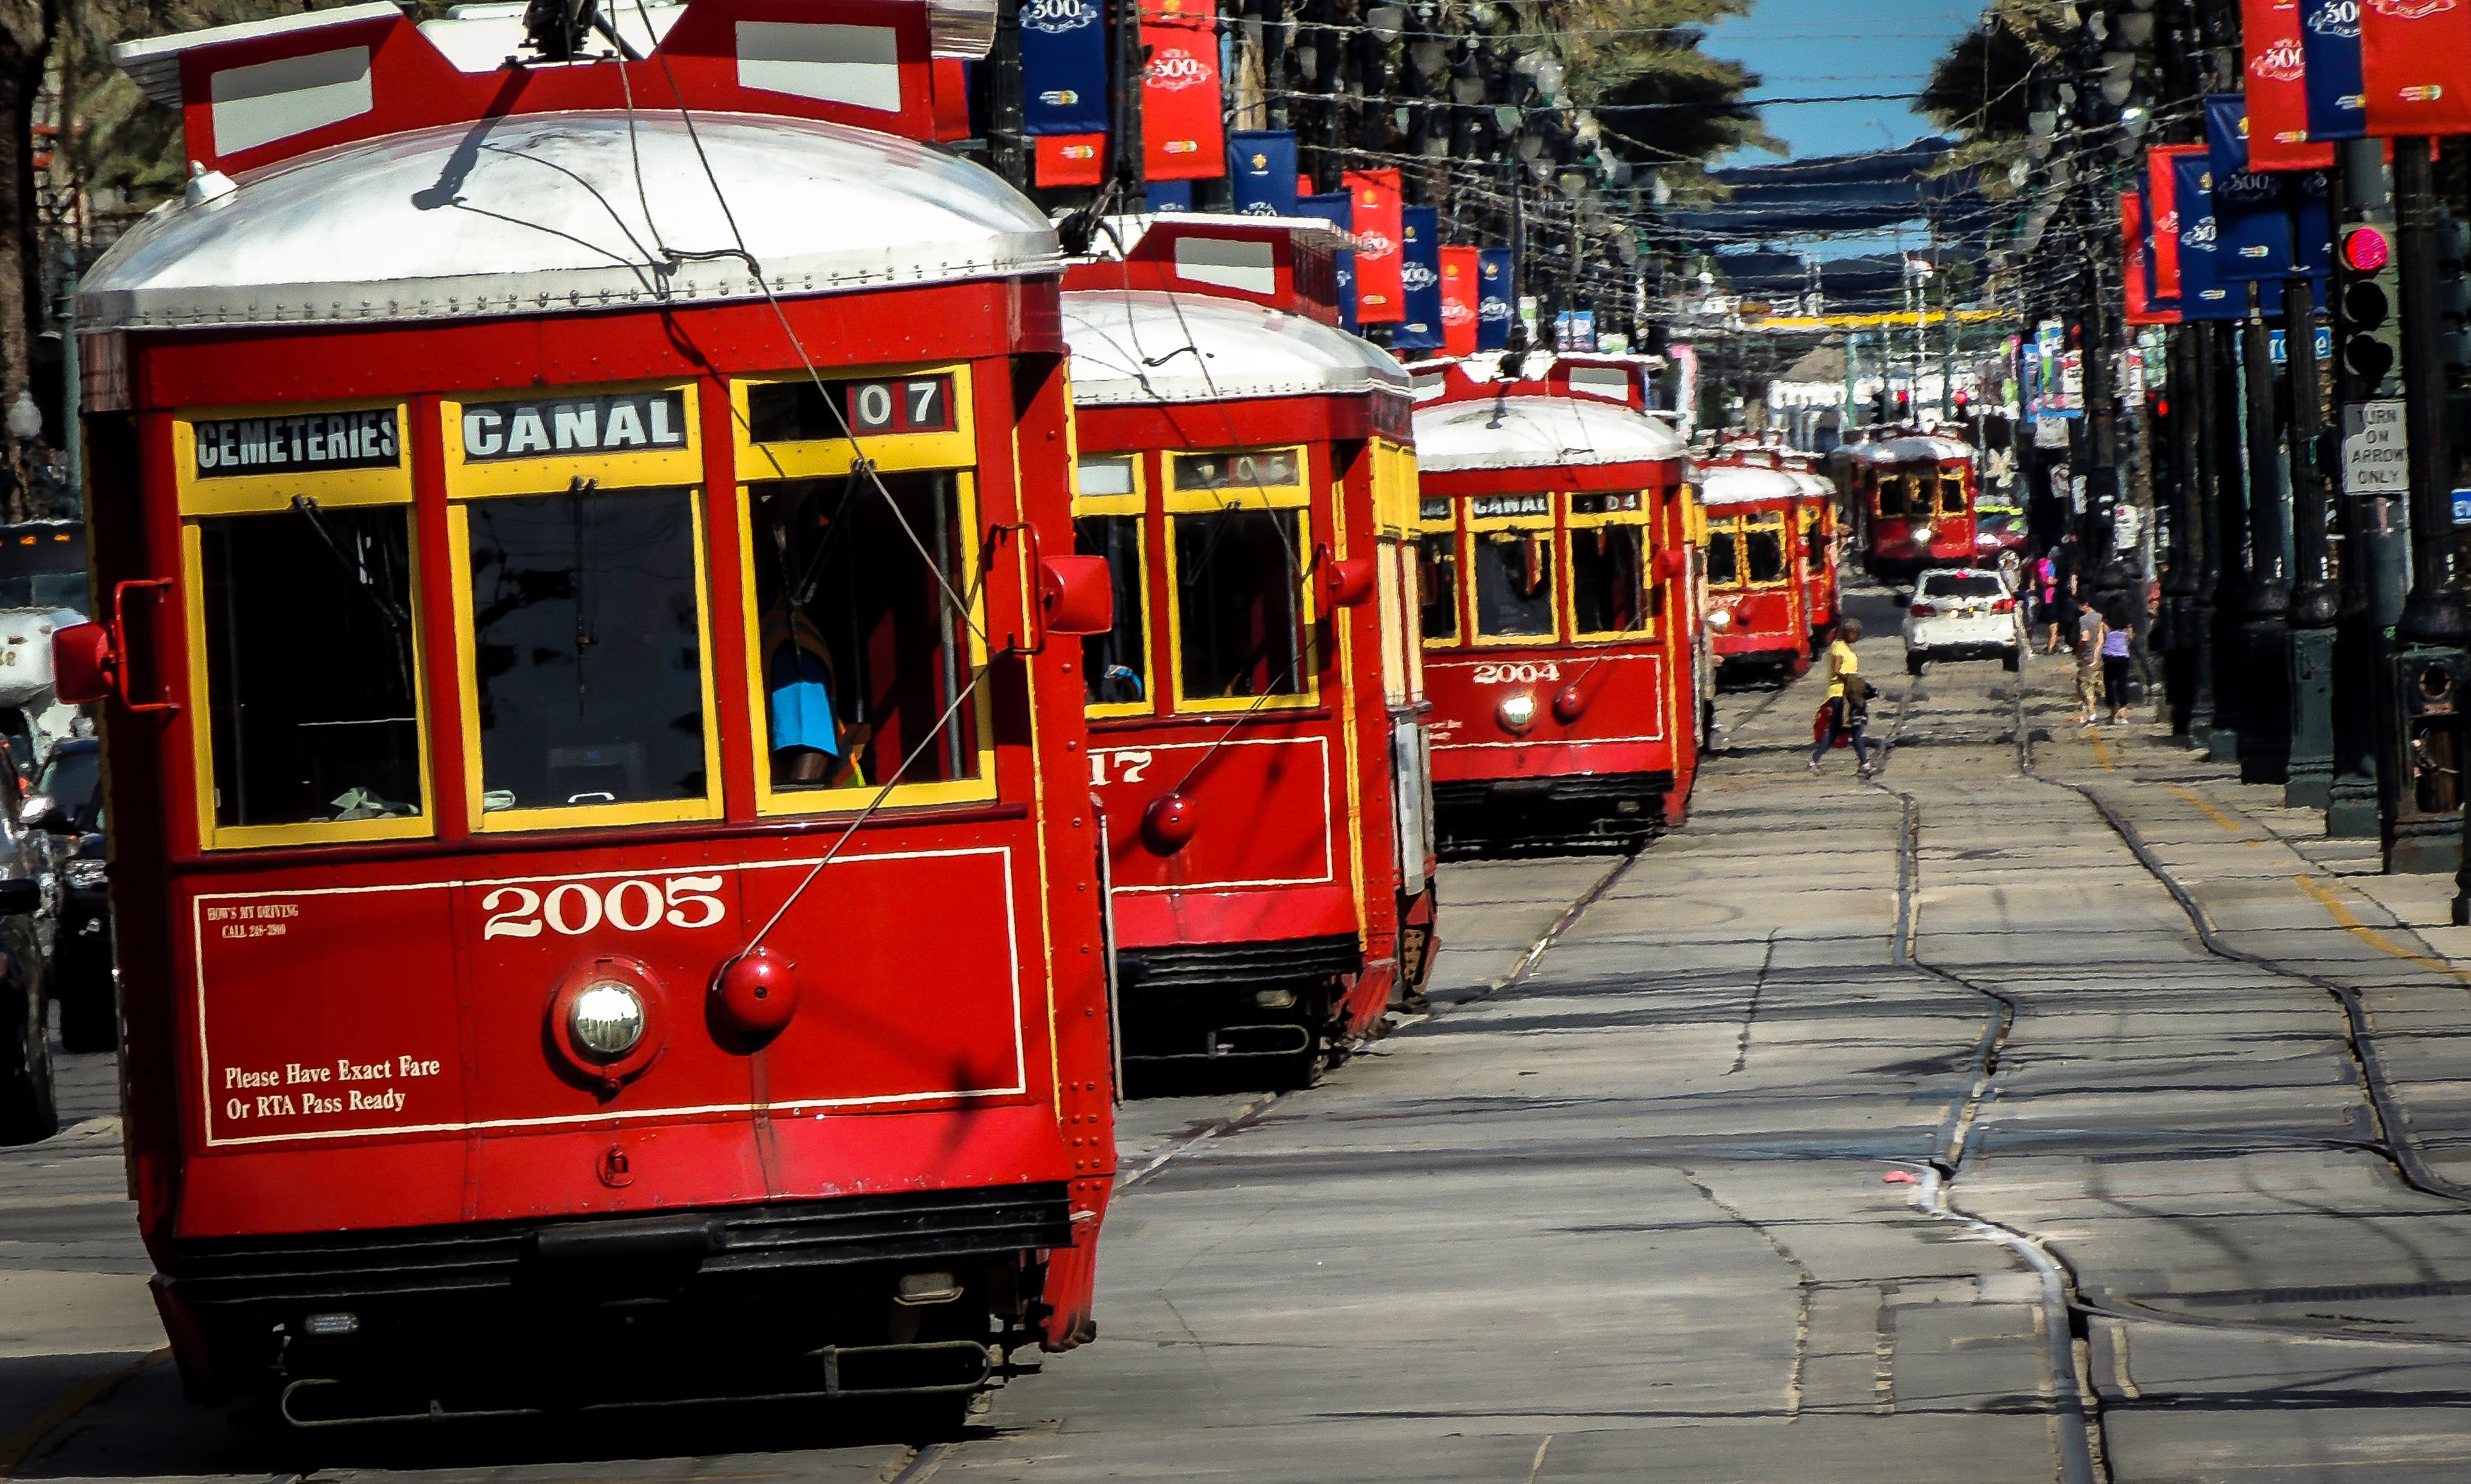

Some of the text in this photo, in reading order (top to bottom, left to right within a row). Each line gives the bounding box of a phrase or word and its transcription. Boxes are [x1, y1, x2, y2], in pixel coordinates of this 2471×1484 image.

[1154, 59, 1197, 78] 300
[859, 381, 937, 425] 07
[197, 409, 398, 469] CEMETERIES
[463, 399, 681, 456] CANAL
[2365, 430, 2389, 445] ON
[2351, 448, 2405, 464] ARROW
[2358, 469, 2400, 485] ONLY
[1473, 664, 1561, 684] 2004
[482, 875, 726, 940] 2005
[222, 924, 247, 938] CALL
[225, 1055, 440, 1089] Please Have Exact Fare
[226, 1088, 406, 1119] Or RTA Pass Ready
